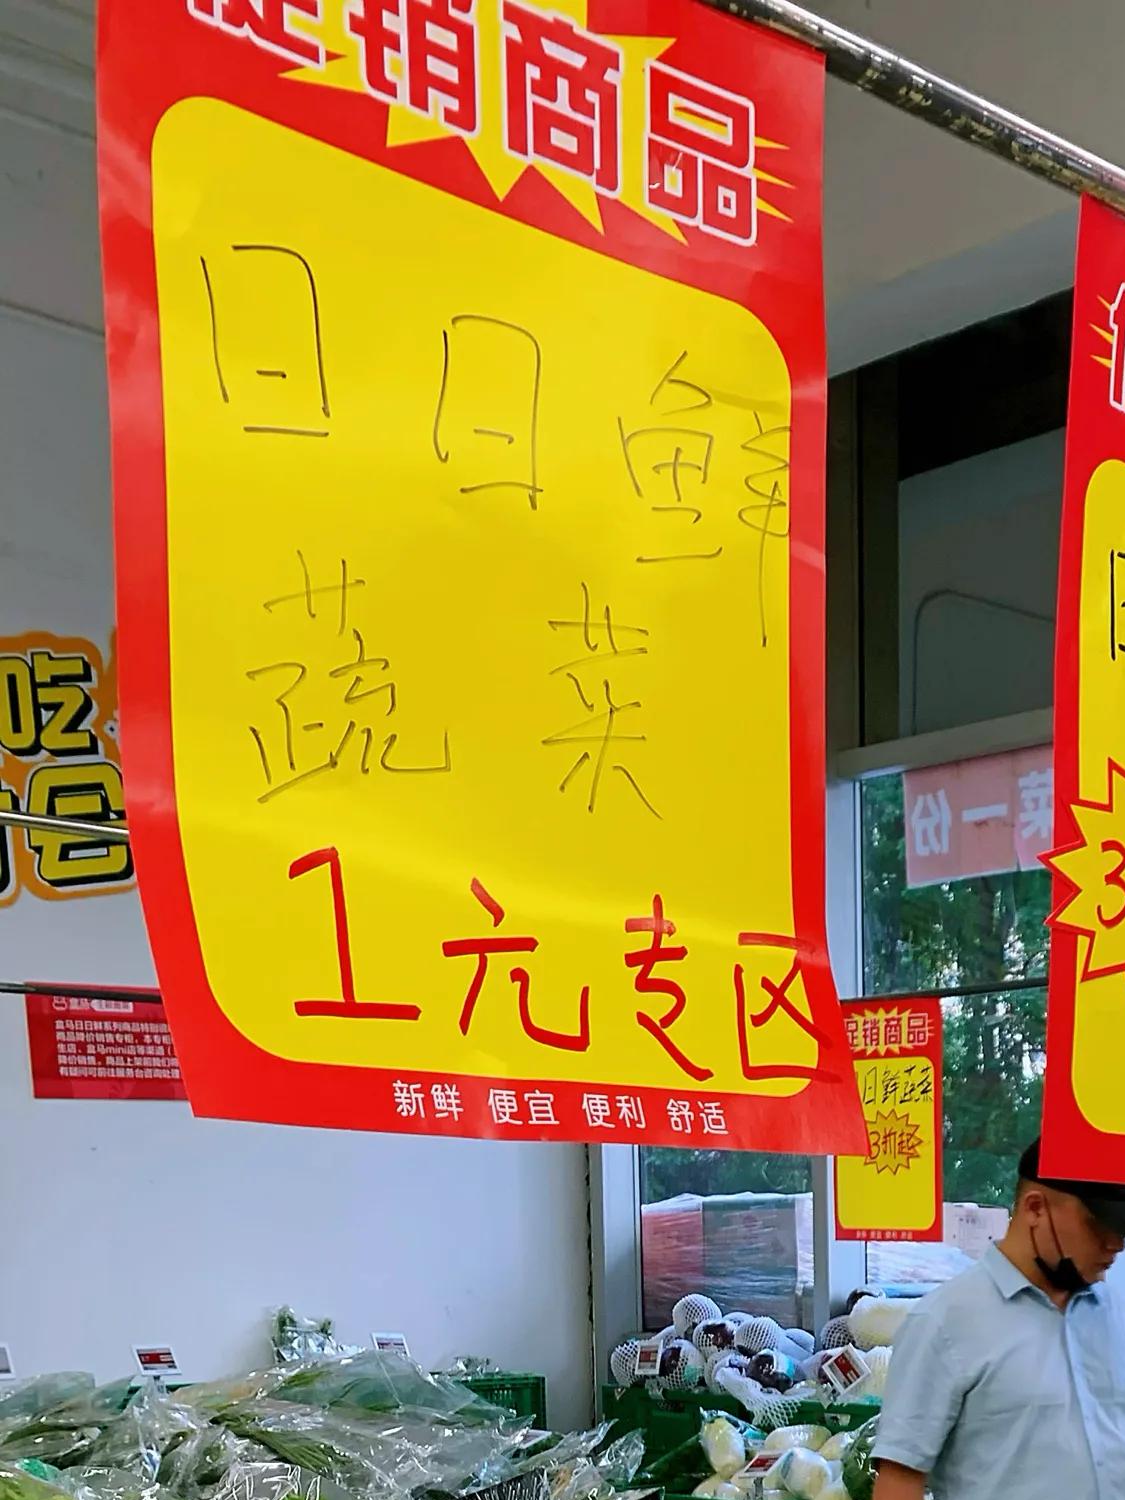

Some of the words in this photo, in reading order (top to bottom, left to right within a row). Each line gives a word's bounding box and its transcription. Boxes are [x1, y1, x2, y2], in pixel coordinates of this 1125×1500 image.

[200, 244, 792, 648] 日日鲜
[246, 550, 662, 820] 蔬菜
[289, 846, 843, 1083] 1元专区
[394, 1080, 464, 1120] 新鲜
[488, 1086, 561, 1127] 便宜
[581, 1093, 647, 1131] 便利
[666, 1097, 730, 1136] 舒适
